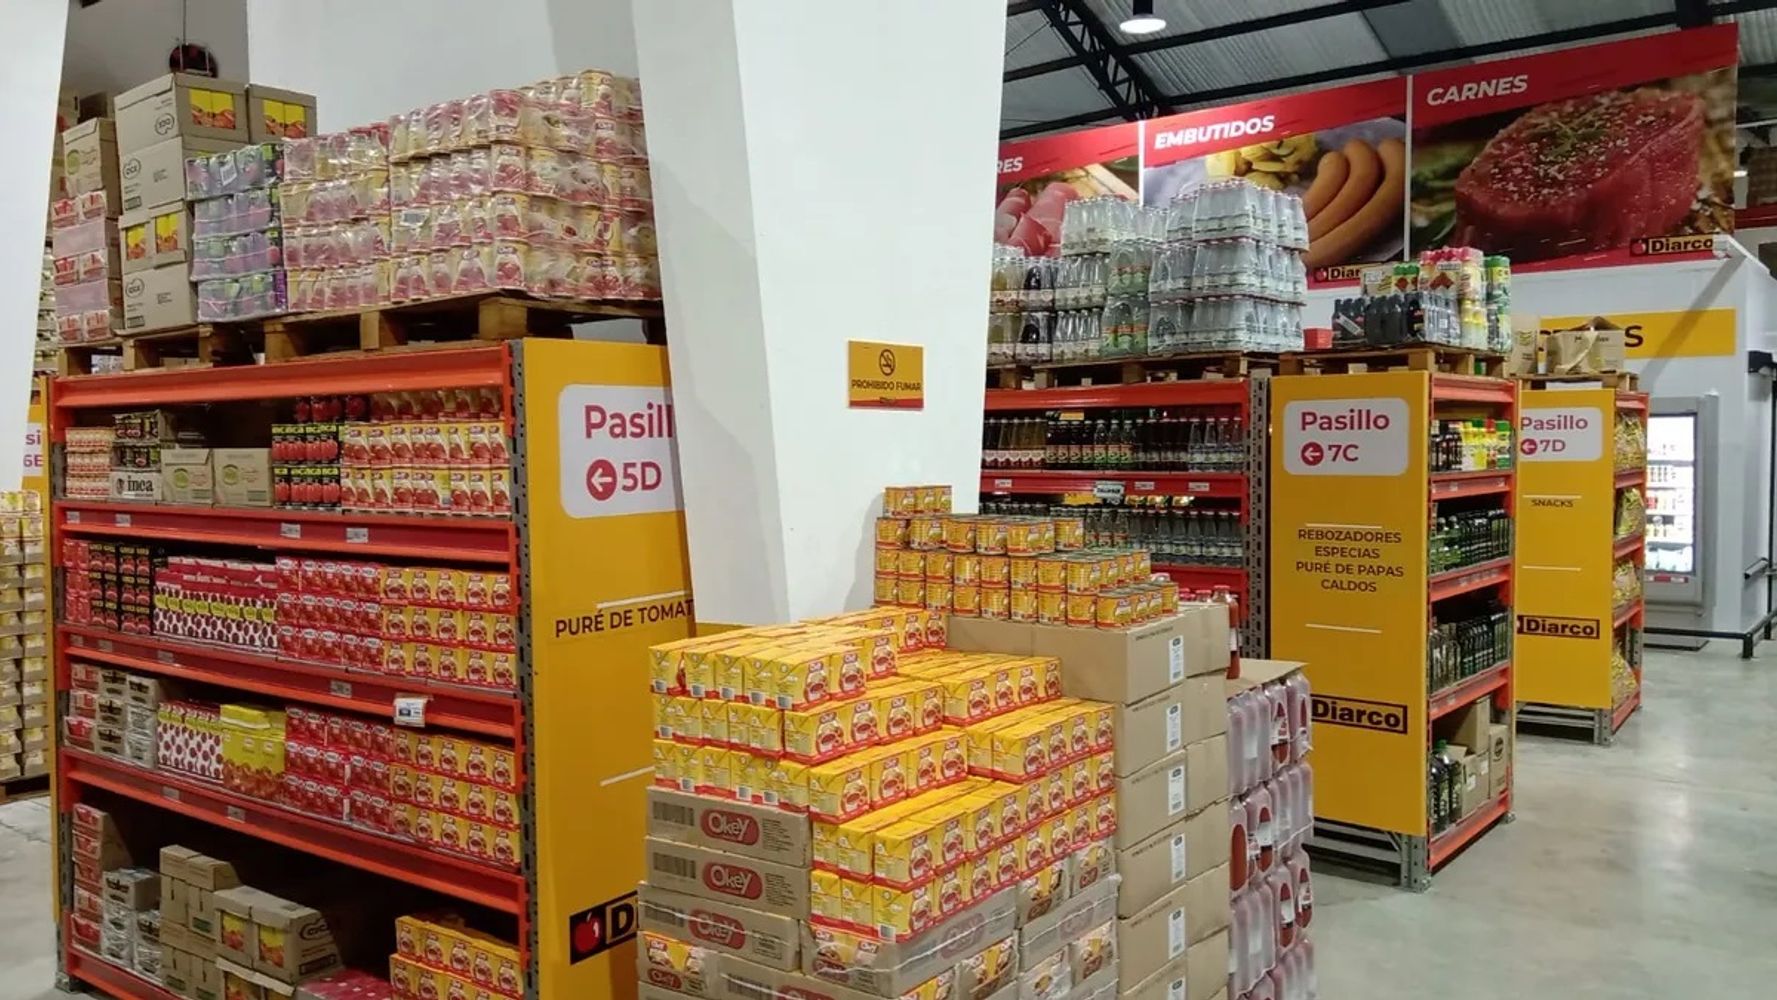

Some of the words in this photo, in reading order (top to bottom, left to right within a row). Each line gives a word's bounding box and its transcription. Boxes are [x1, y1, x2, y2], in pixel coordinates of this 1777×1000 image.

[1427, 75, 1528, 106] CARNES
[1154, 115, 1275, 149] EMBUTIDOS
[1651, 239, 1713, 252] Diarco
[852, 379, 895, 390] PROHIBIDO
[895, 381, 921, 391] FUMAR
[585, 402, 673, 438] Pasill
[1301, 409, 1390, 431] Pasillo
[1520, 415, 1588, 430] Pasillo
[1328, 444, 1359, 462] 7C
[1540, 439, 1566, 452] 7D
[127, 475, 153, 492] inca
[622, 461, 662, 491] 5D
[1531, 499, 1573, 507] SNACKS
[1298, 529, 1402, 543] REBOZADORES
[1315, 546, 1381, 558] ESPECIAS
[1296, 561, 1332, 573] PURÉ
[1335, 564, 1355, 574] DE
[1357, 565, 1404, 577] PAPAS
[1321, 579, 1377, 592] CALDOS
[555, 609, 604, 638] PURÉ
[610, 610, 633, 628] DE
[1526, 618, 1594, 635] Diarco
[1312, 699, 1400, 728] Diarco
[708, 812, 749, 841] Okey
[711, 865, 752, 895] Okey
